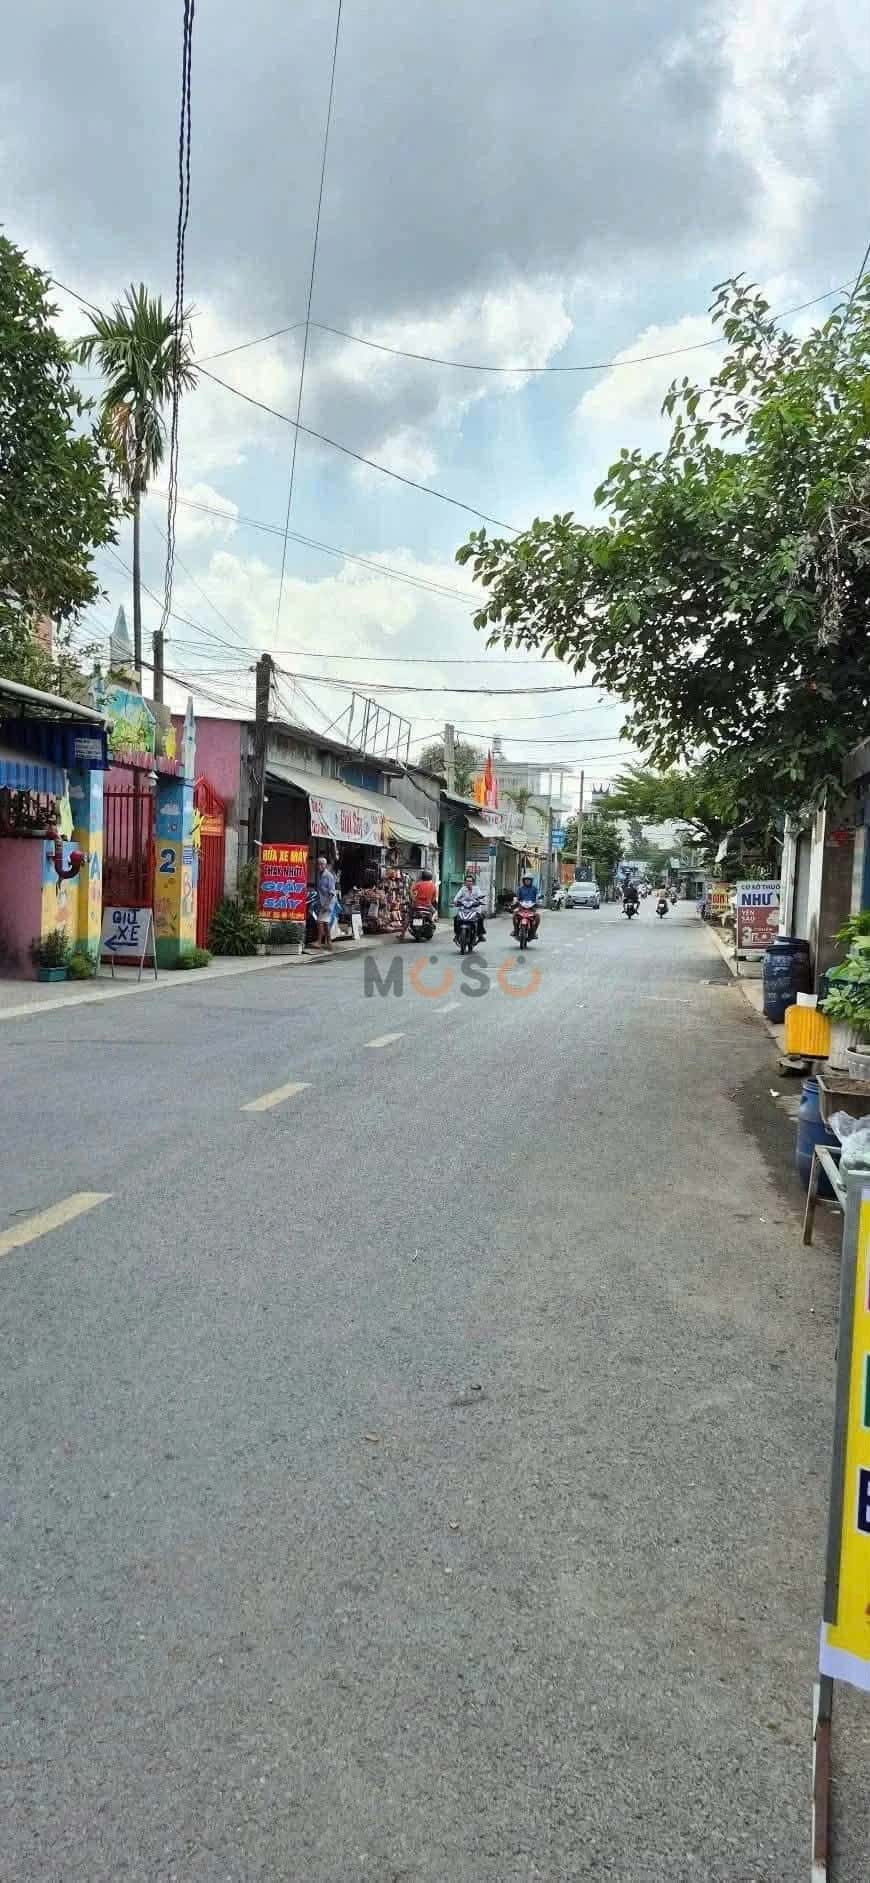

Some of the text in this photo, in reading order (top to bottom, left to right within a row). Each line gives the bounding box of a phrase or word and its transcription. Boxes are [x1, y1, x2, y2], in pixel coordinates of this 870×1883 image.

[159, 848, 176, 873] 2
[279, 849, 290, 863] XE
[741, 892, 773, 906] NHƯ
[117, 925, 141, 941] XE
